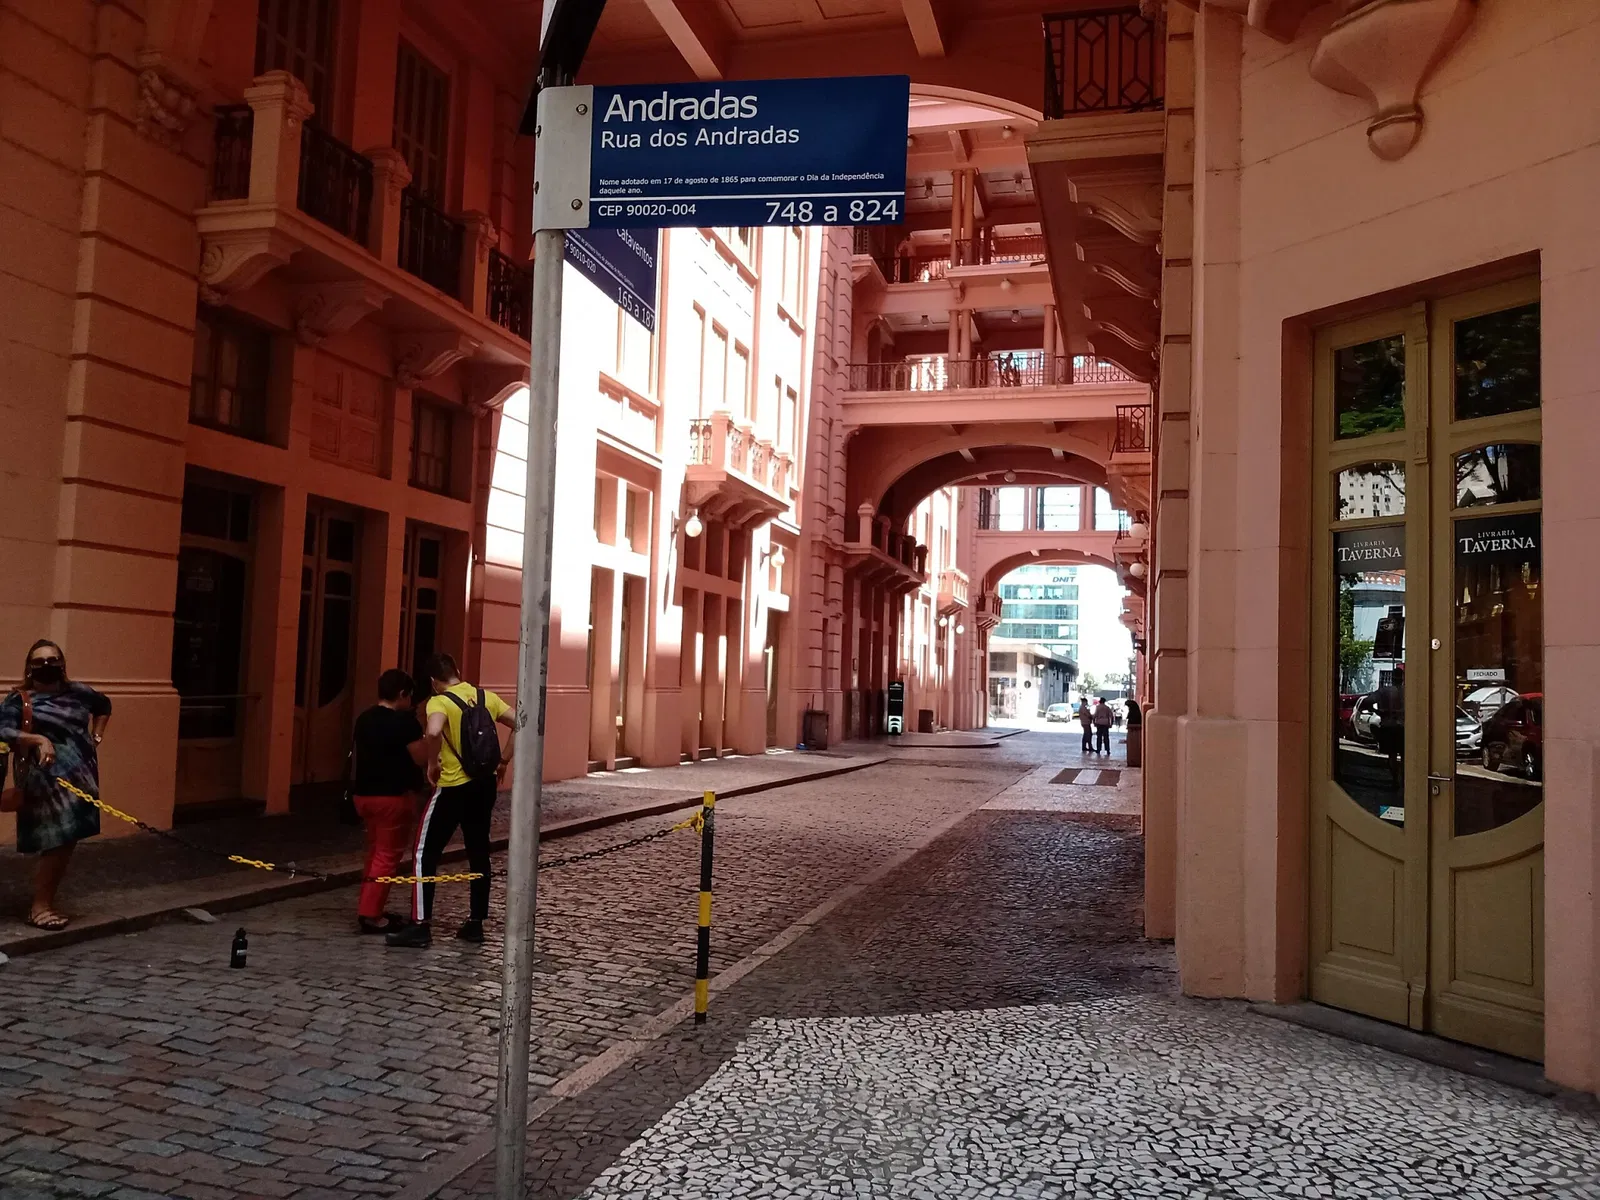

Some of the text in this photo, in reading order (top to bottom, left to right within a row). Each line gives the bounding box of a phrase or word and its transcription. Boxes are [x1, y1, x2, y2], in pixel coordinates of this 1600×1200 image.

[603, 89, 758, 123] Andradas
[601, 125, 800, 149] Rua dos Andradas
[599, 178, 620, 186] Nome
[620, 177, 649, 186] adotado
[663, 177, 673, 185] 17
[684, 177, 709, 186] agosto
[709, 176, 719, 184] de
[720, 175, 739, 183] 1865
[740, 176, 757, 184] para
[757, 175, 798, 183] comemorar
[820, 173, 830, 181] da
[831, 172, 885, 182] Independência
[599, 186, 643, 195] daquele ano.
[597, 203, 697, 217] CEP 90020-004
[765, 199, 899, 223] 748 a 824
[617, 286, 655, 330] 165 a 187
[1477, 529, 1516, 539] LIVRARIA
[1353, 540, 1386, 548] LIVRARIA
[1459, 537, 1536, 554] TAVERNA
[1338, 547, 1403, 562] TAVERNA
